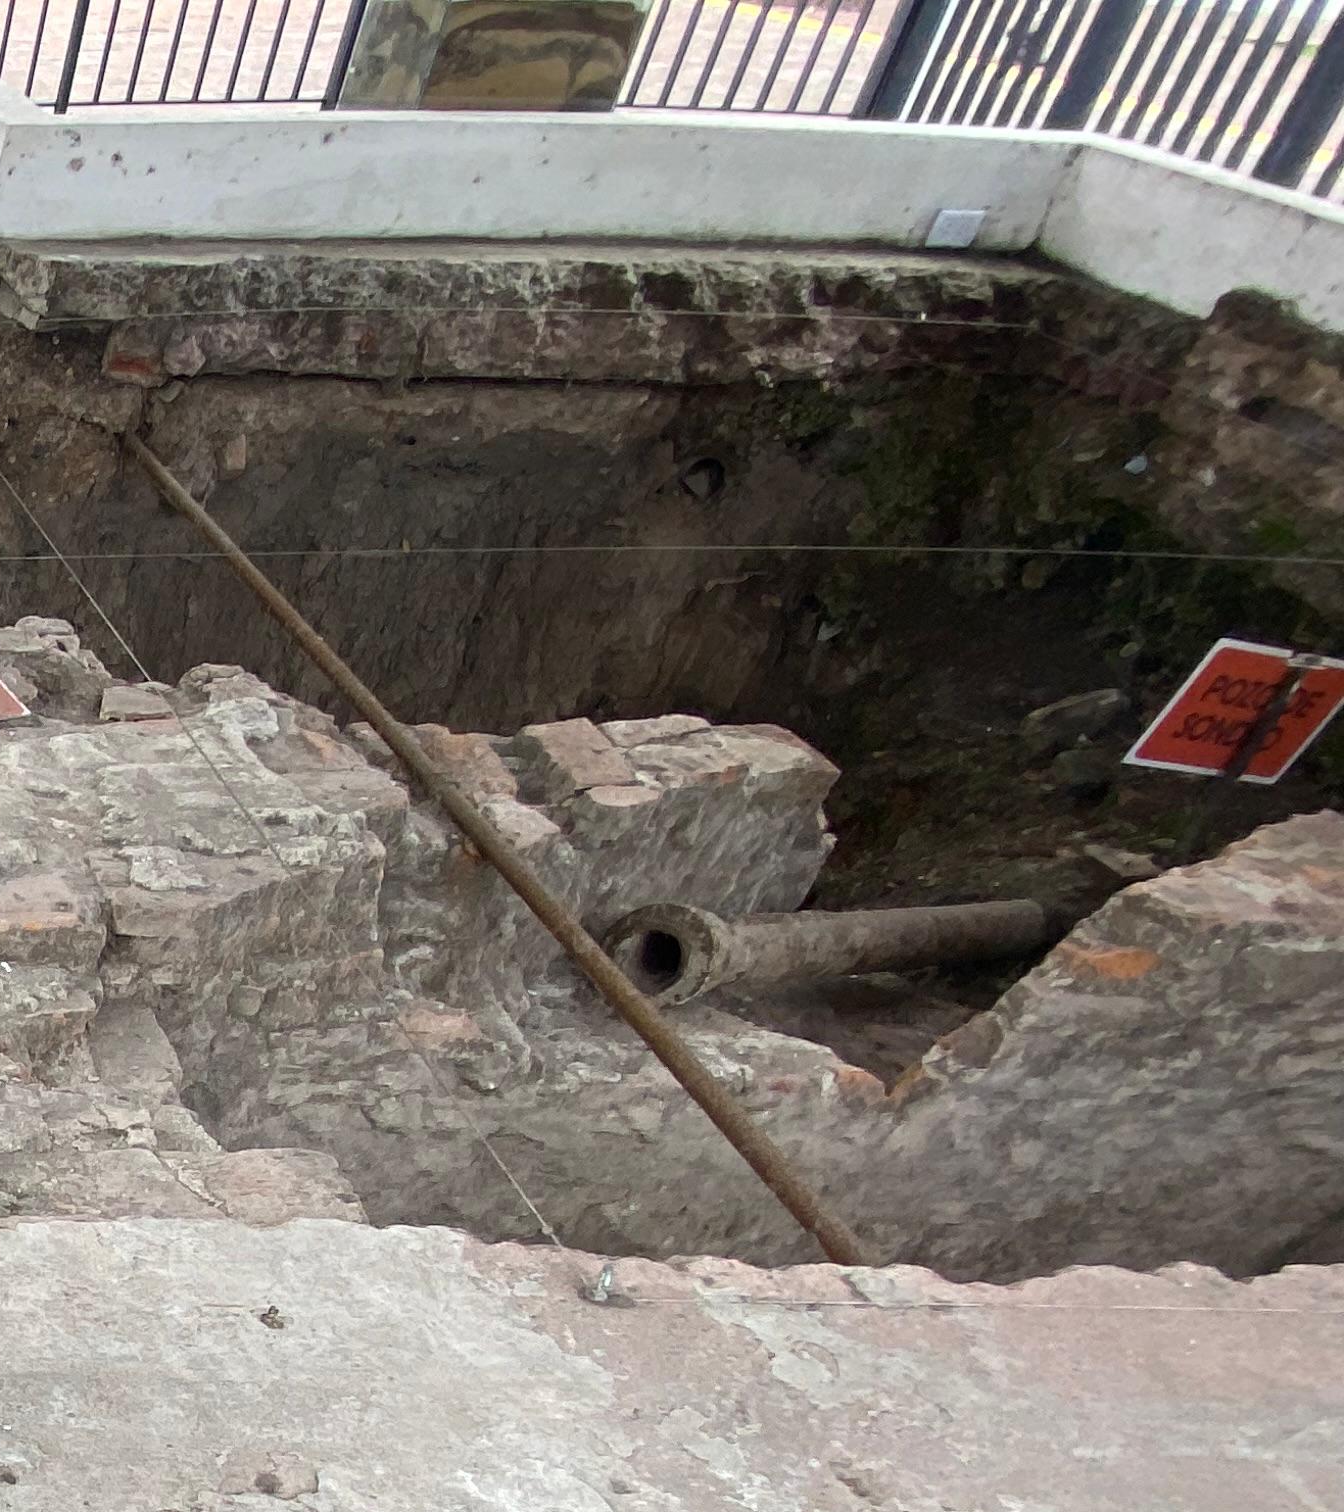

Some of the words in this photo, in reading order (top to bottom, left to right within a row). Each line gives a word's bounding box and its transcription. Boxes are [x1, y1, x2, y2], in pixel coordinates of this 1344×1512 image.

[1200, 675, 1277, 710] POZO
[1281, 687, 1325, 719] DE
[1173, 712, 1284, 751] SONDO
